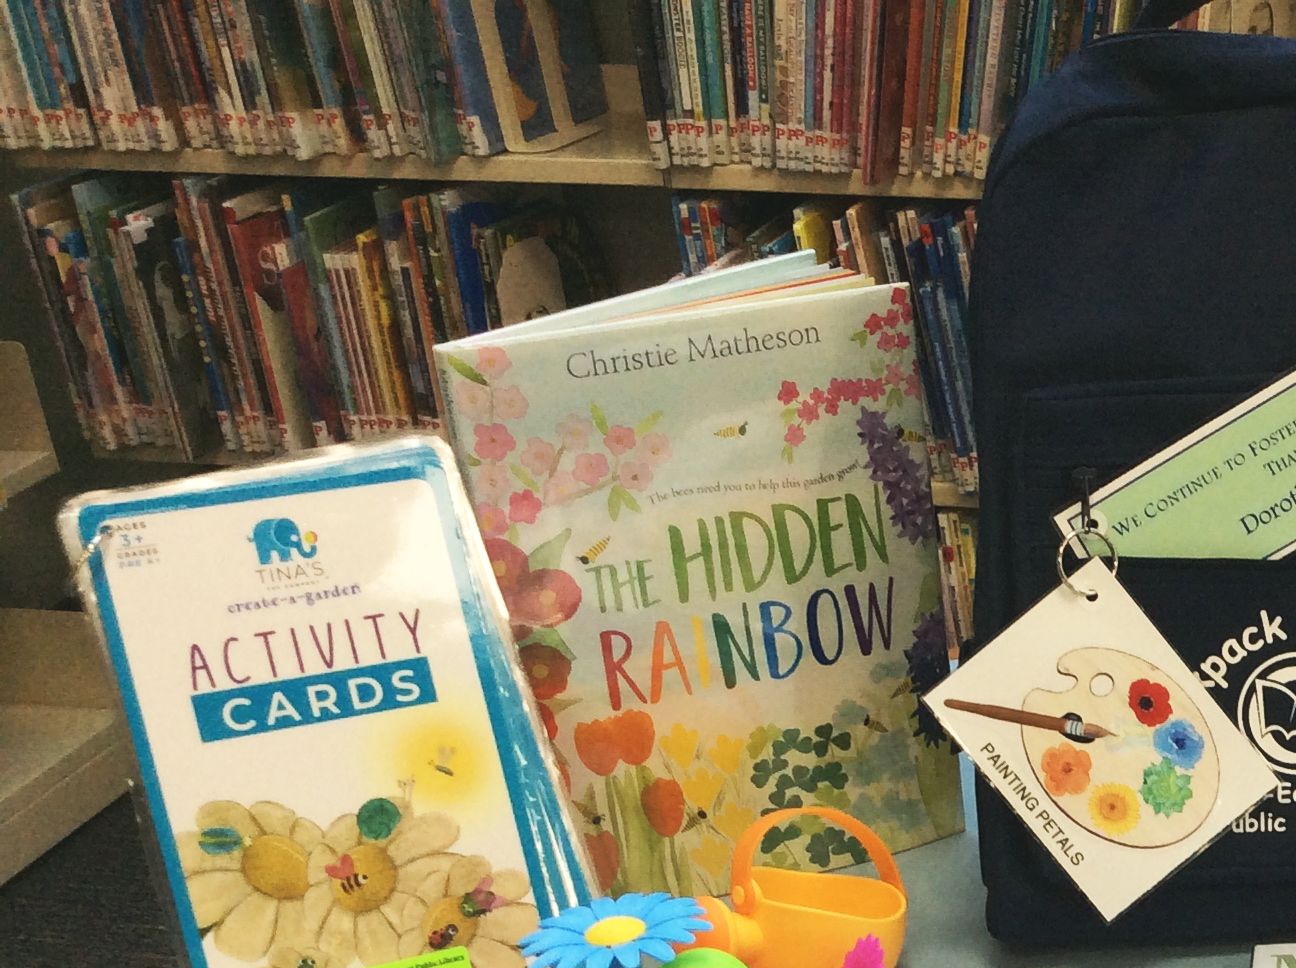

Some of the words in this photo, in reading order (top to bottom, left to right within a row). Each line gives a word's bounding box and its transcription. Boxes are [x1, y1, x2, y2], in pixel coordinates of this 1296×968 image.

[565, 346, 679, 381] Christie
[687, 321, 822, 363] Matheson
[723, 484, 742, 498] you
[745, 482, 753, 491] to
[758, 479, 780, 493] help
[782, 475, 801, 489] this
[803, 472, 835, 490] garden
[255, 561, 325, 584] TINA'S
[584, 558, 662, 614] THE
[667, 484, 890, 604] HIDDEN
[227, 584, 361, 614] create-a-garden
[190, 608, 424, 691] ACTIVITY
[599, 576, 895, 712] RAINBOW
[221, 669, 422, 732] CARDS
[979, 739, 1041, 816] PAINTING
[1034, 808, 1086, 869] PETALS
[1231, 811, 1286, 833] ublic
